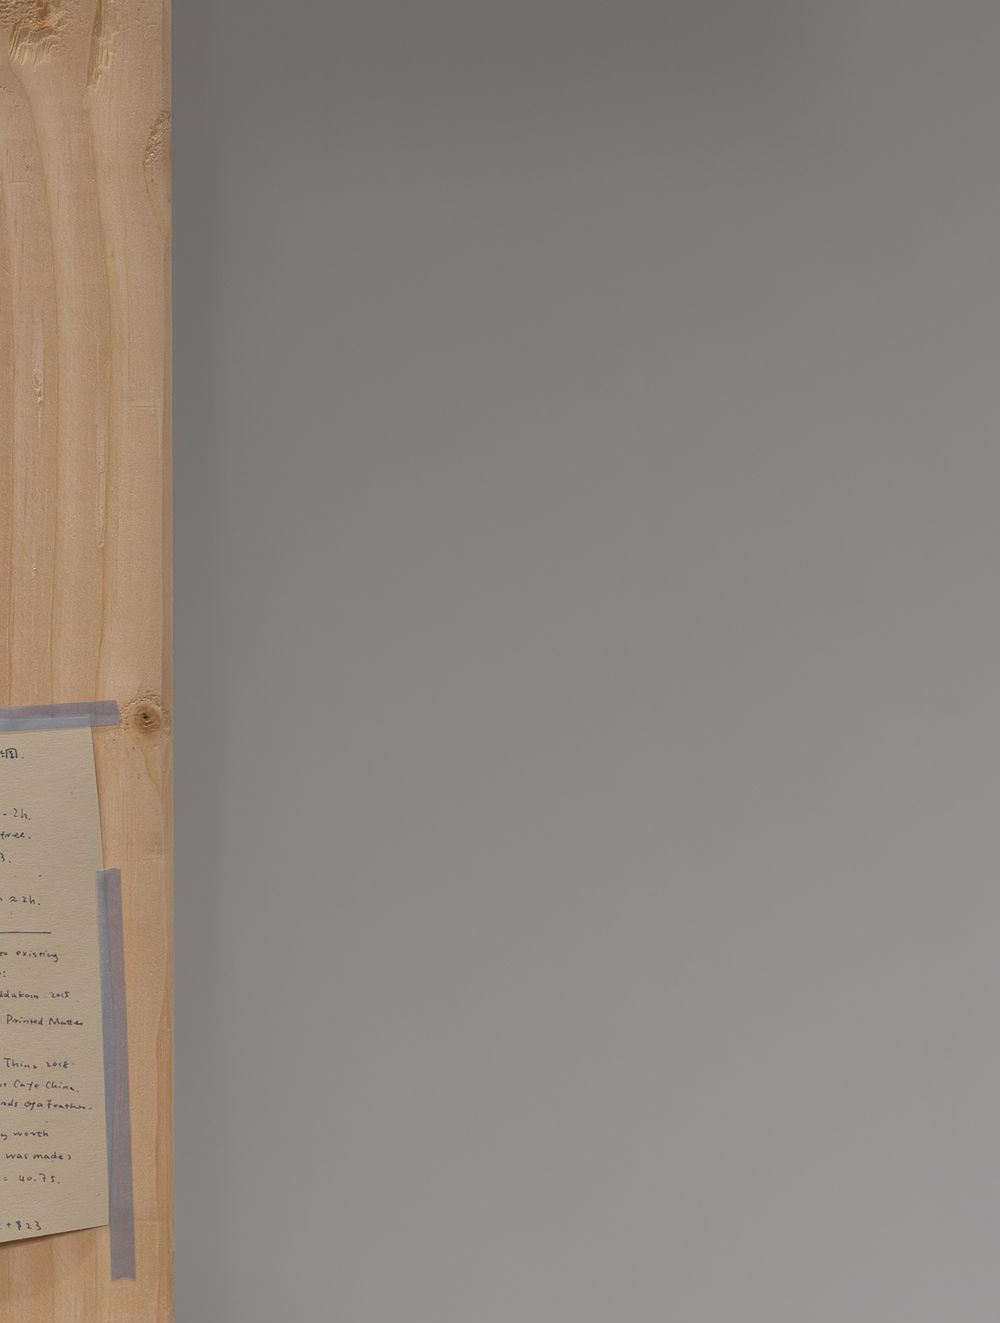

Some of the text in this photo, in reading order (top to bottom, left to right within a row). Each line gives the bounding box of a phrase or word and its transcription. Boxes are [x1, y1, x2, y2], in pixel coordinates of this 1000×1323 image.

[16, 951, 58, 962] existing
[7, 1014, 43, 1025] Printed
[49, 1016, 83, 1026] Matter
[13, 1129, 48, 1138] worth
